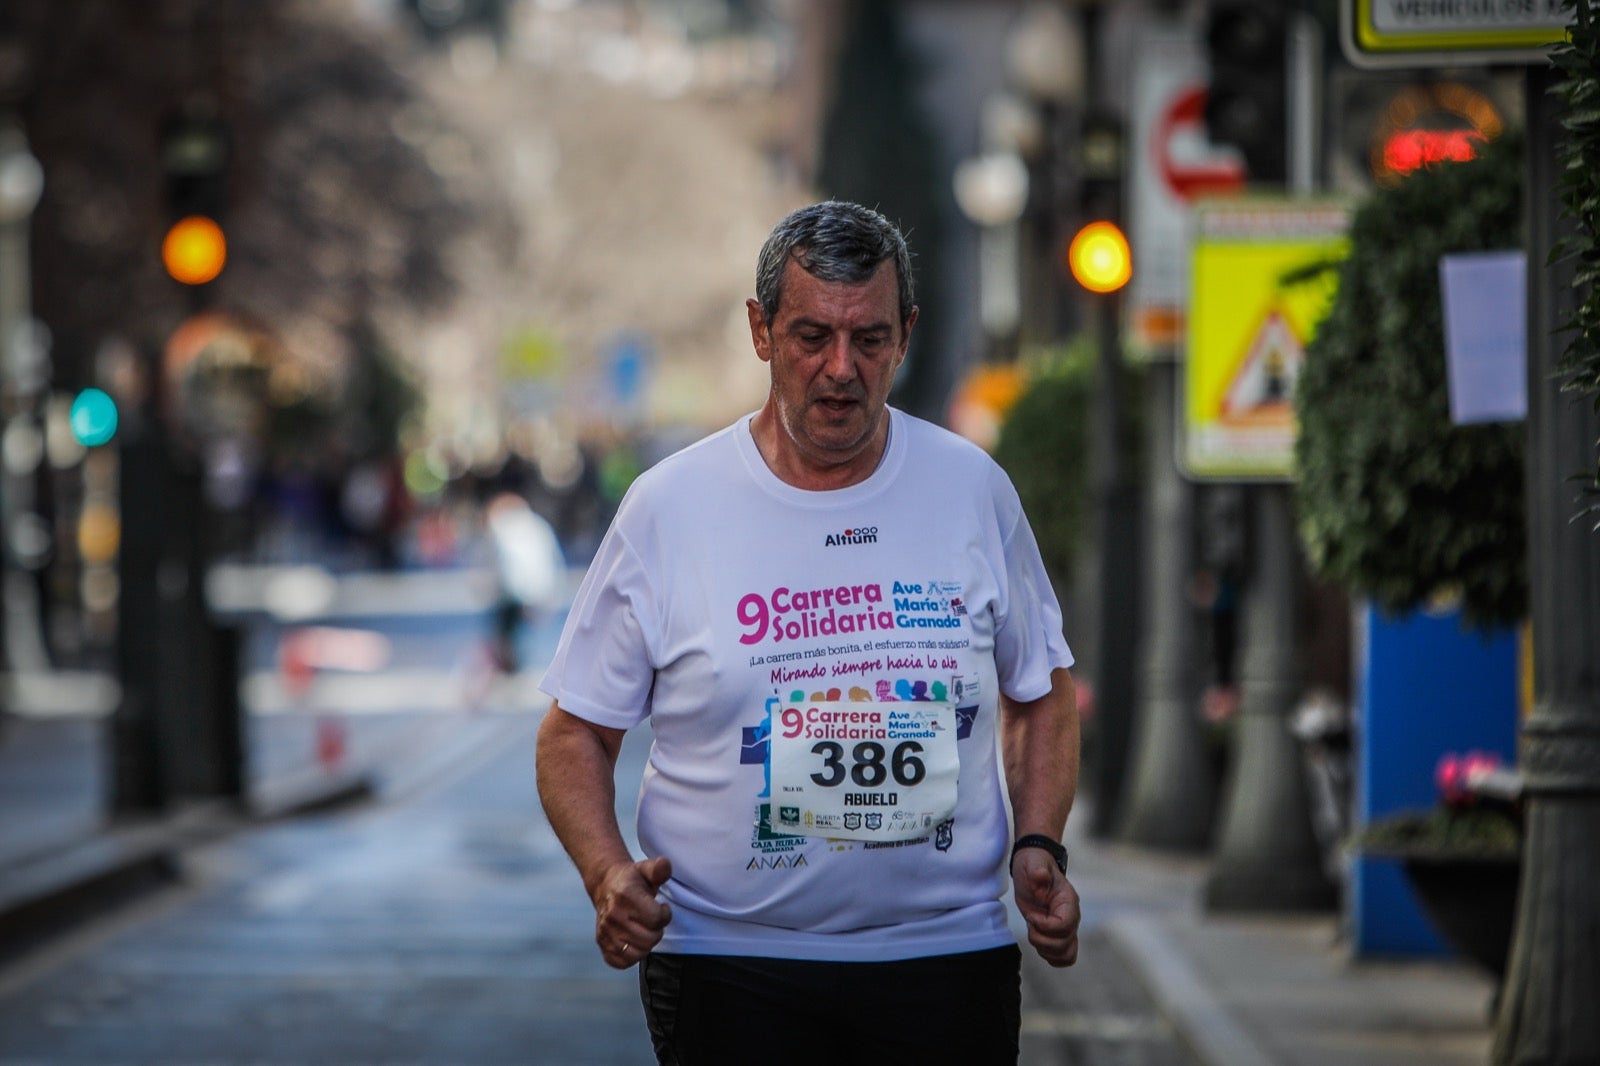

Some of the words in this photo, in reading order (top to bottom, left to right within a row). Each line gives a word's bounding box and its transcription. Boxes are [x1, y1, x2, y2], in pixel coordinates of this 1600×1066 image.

[825, 529, 877, 547] Altium
[892, 581, 922, 595] Ave
[771, 583, 882, 614] Carrera
[894, 597, 939, 612] María
[736, 593, 770, 645] 9
[772, 605, 895, 643] Solidaria
[896, 614, 961, 629] Granada
[766, 651, 803, 664] carrera
[804, 647, 826, 659] más
[828, 643, 863, 657] bonita,
[864, 640, 873, 652] el
[874, 638, 916, 652] esfuerzo
[918, 638, 937, 650] más
[770, 662, 826, 684] Mirando
[831, 660, 882, 677] siempre
[887, 654, 923, 670] hacia
[927, 654, 938, 669] lo
[782, 708, 804, 739] 9
[806, 708, 881, 724] Carrera
[889, 711, 910, 721] Ave
[805, 724, 887, 740] Solidaria
[889, 720, 921, 730] María
[888, 730, 936, 739] Granada
[810, 740, 927, 788] 386
[844, 793, 898, 806] ABUELO
[751, 840, 773, 849] CAJA
[775, 837, 807, 847] RURAL
[745, 853, 808, 871] ANAYA
